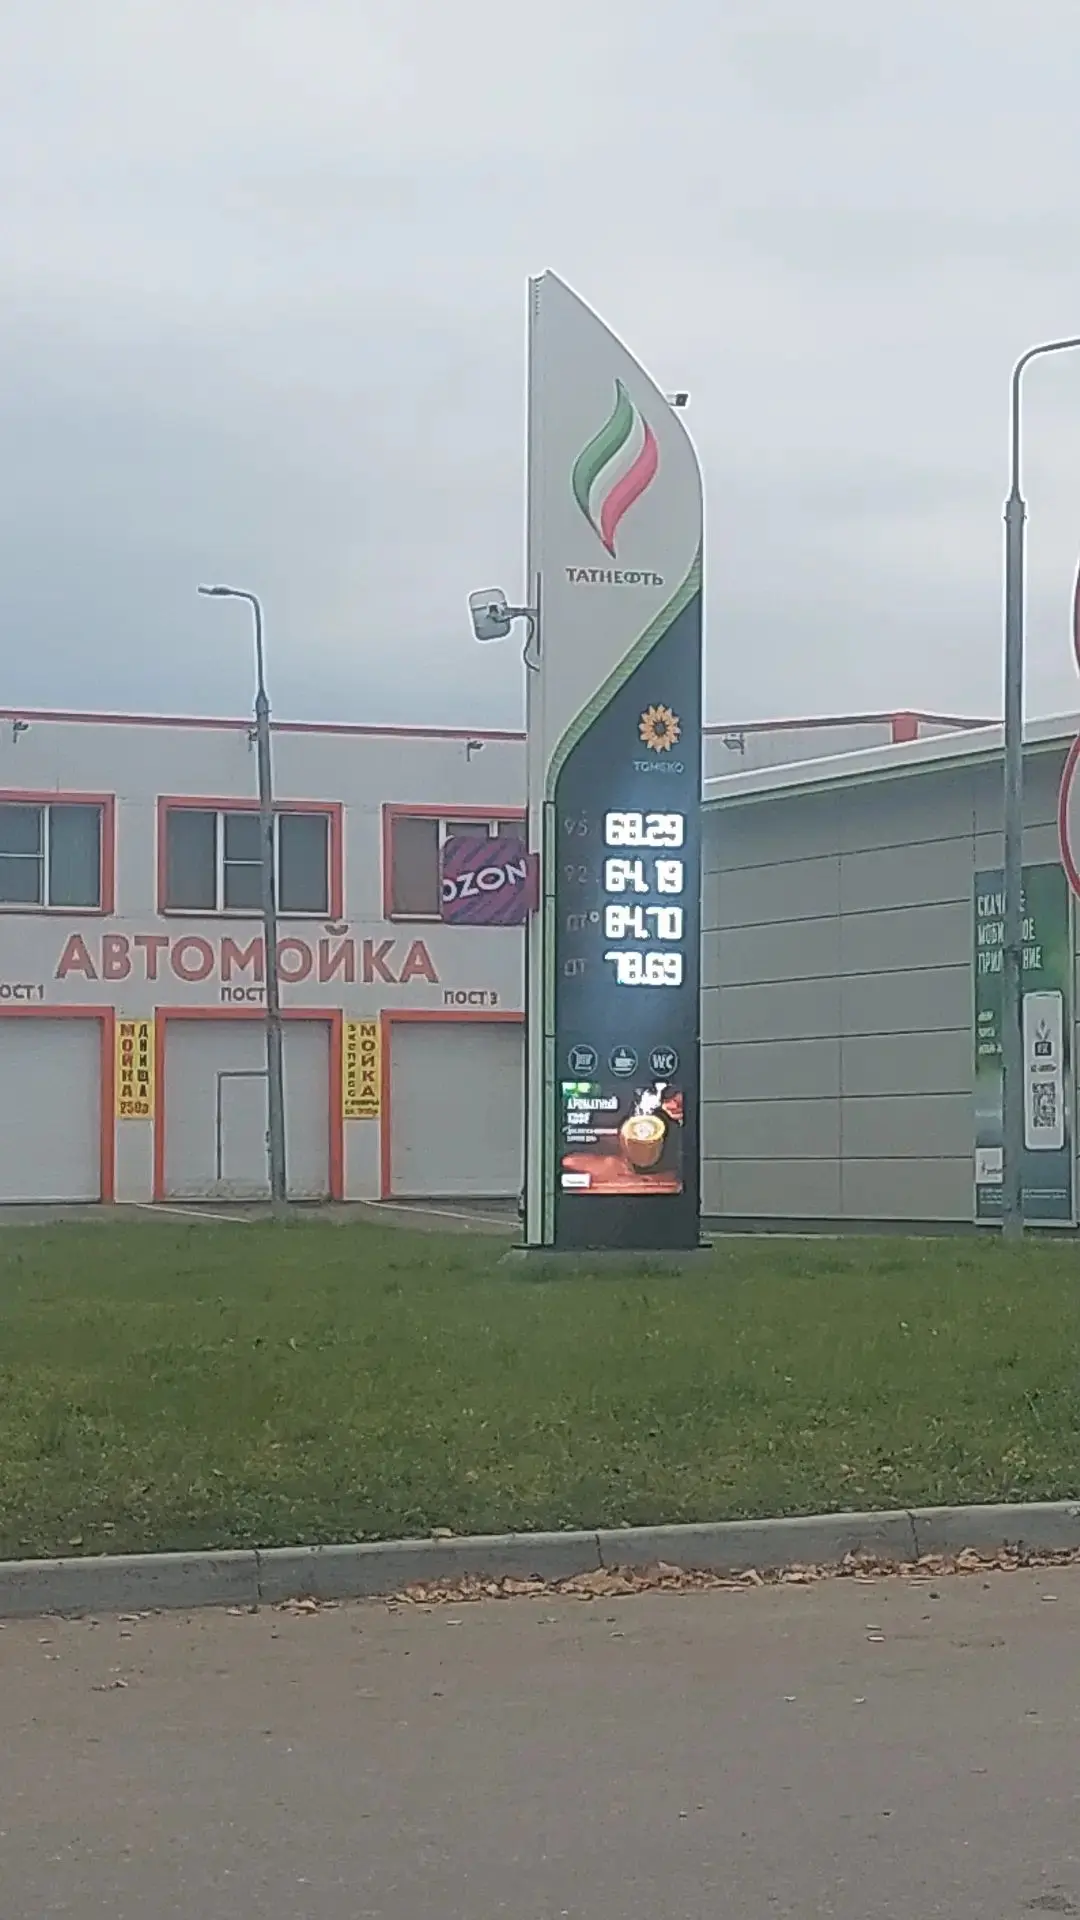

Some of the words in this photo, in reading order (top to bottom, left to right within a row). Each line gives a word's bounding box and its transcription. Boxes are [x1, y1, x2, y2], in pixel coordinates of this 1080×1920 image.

[566, 567, 665, 586] ТАТНЕФТЬ
[443, 859, 527, 902] OZON
[55, 924, 440, 984] АВТОМОЙКА
[0, 984, 35, 1000] ОСТ
[221, 987, 266, 1002] ПОСТ
[444, 990, 487, 1005] ПОСТ
[119, 1023, 136, 1098] МОЙКА
[136, 1023, 150, 1098] ДНИЩА
[360, 1024, 377, 1098] МОЙКА
[652, 1054, 674, 1071] WC
